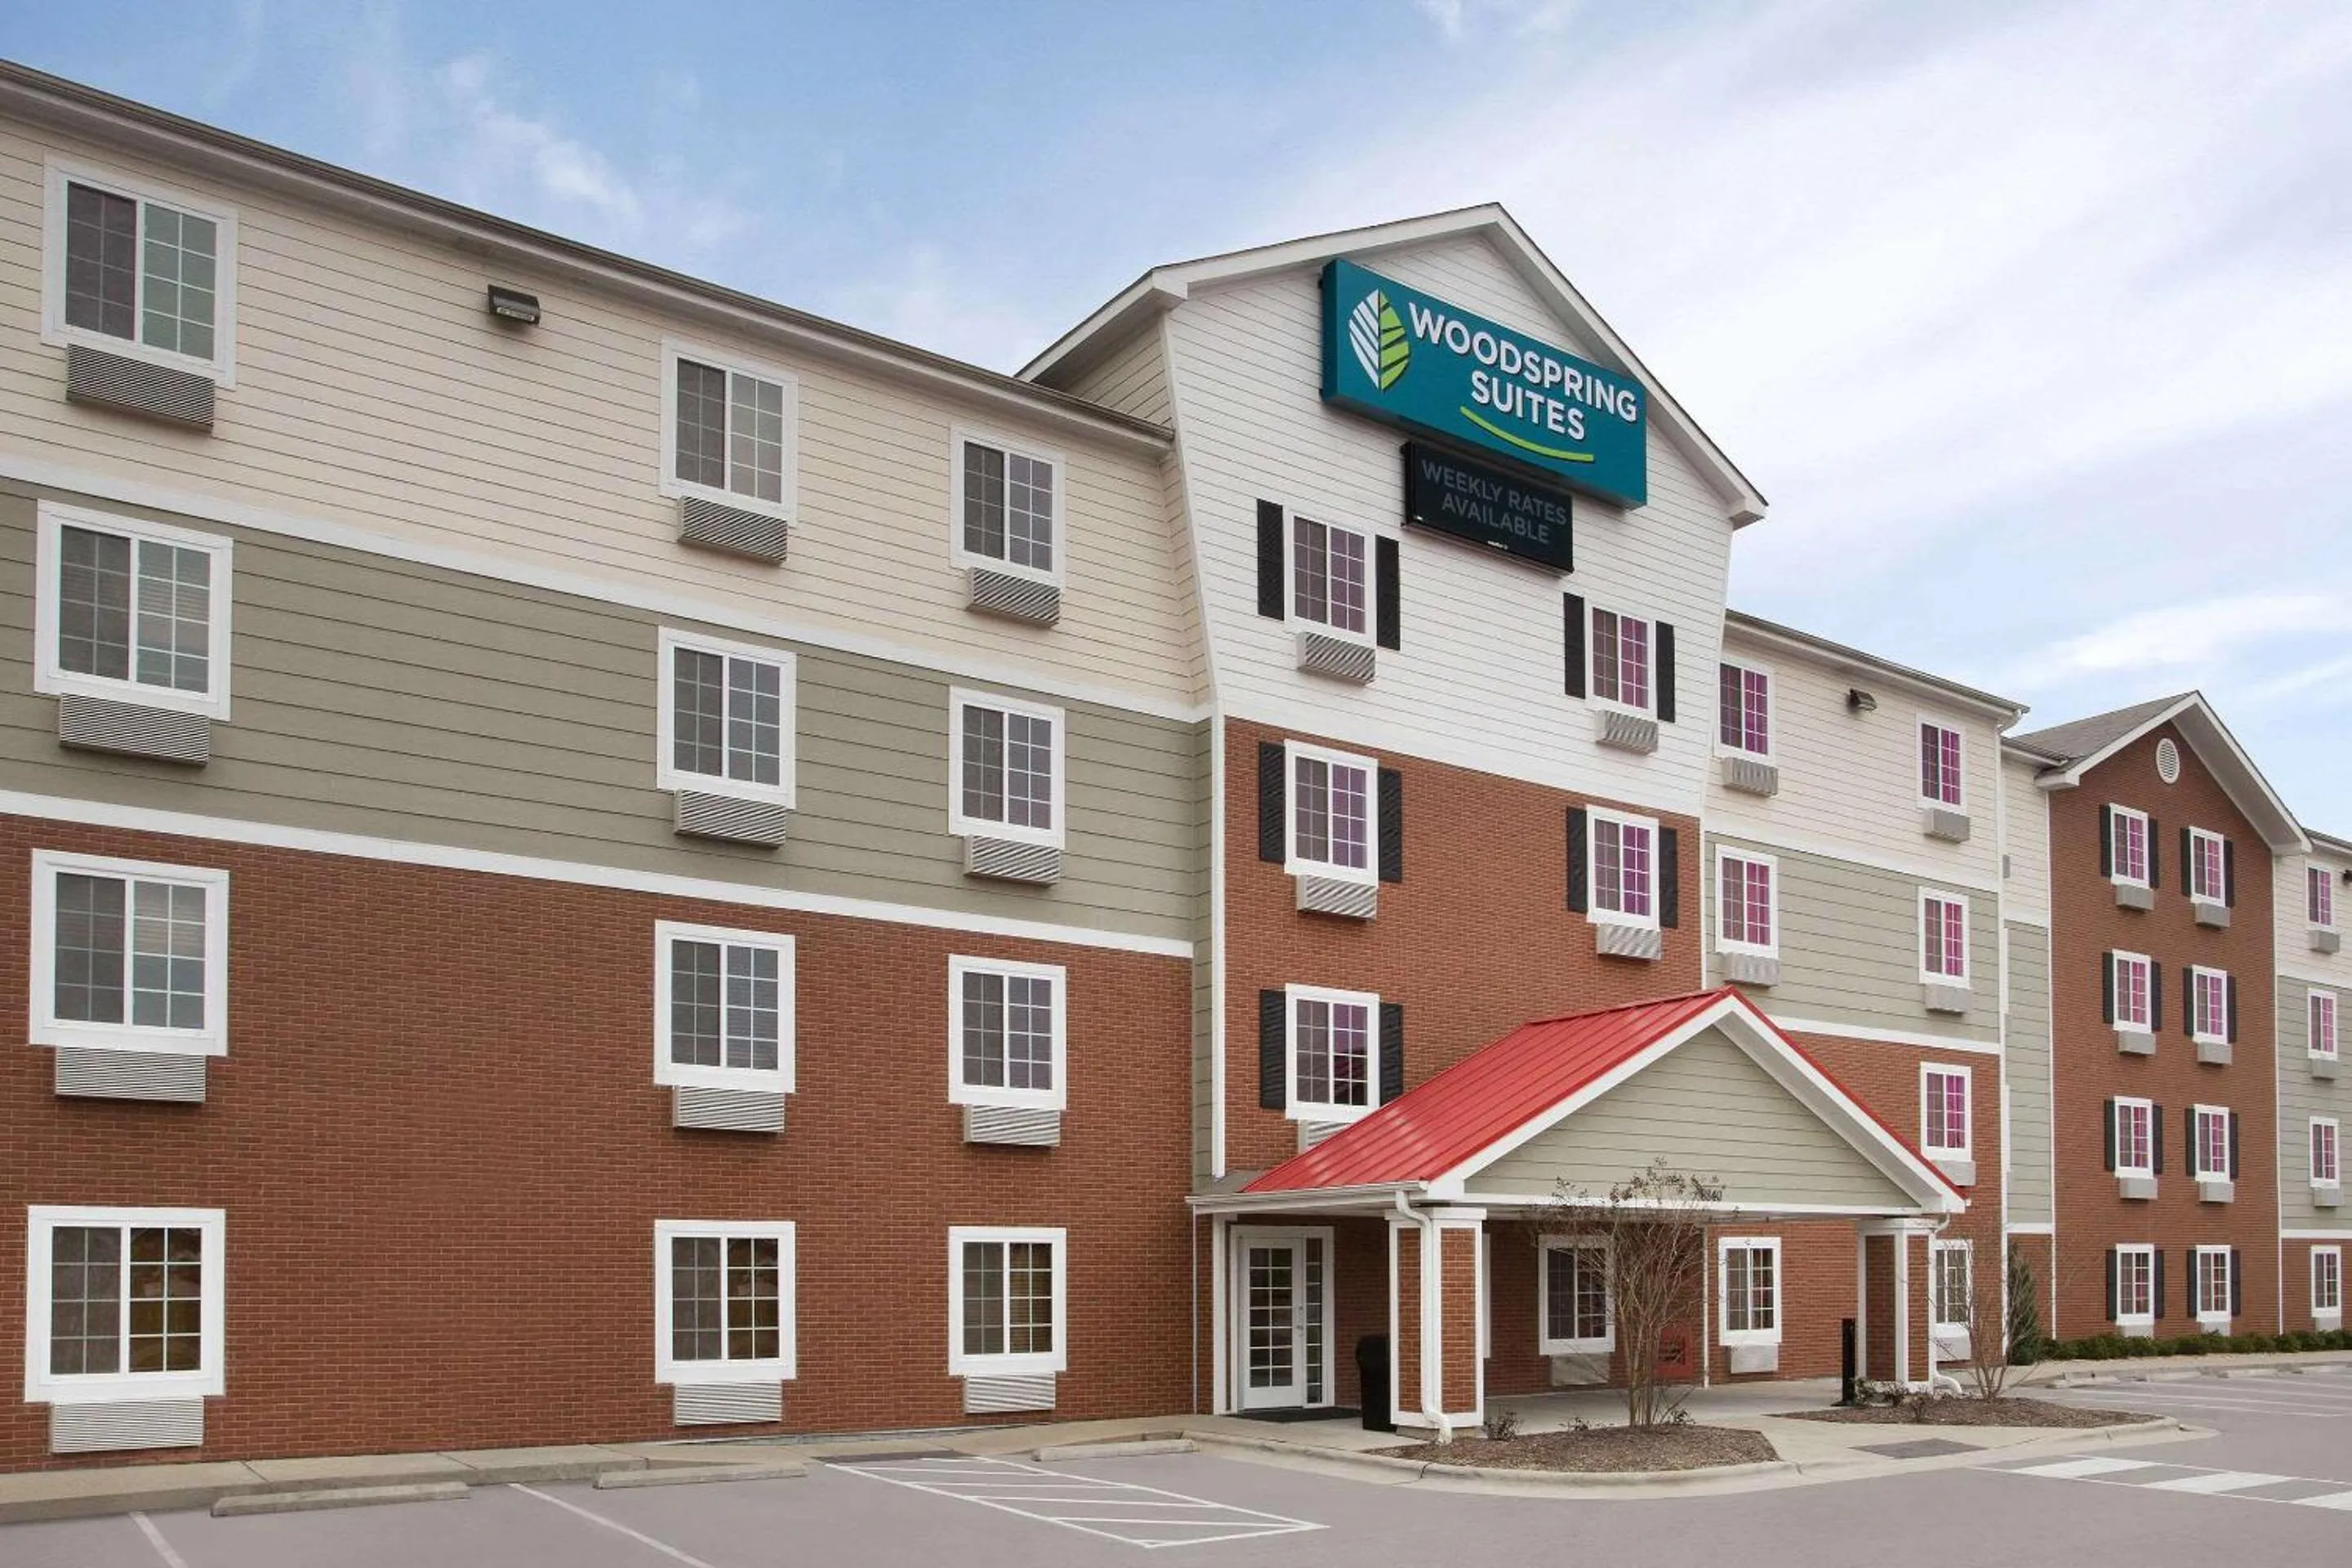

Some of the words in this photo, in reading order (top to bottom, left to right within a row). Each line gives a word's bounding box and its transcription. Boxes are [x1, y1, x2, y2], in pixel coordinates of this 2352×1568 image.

[1409, 302, 1637, 422] WOODSPRING
[1471, 370, 1585, 440] SUITES
[1421, 459, 1503, 502] WEEKLY
[1508, 490, 1568, 526] RATES
[1442, 492, 1549, 545] AVAILABLE
